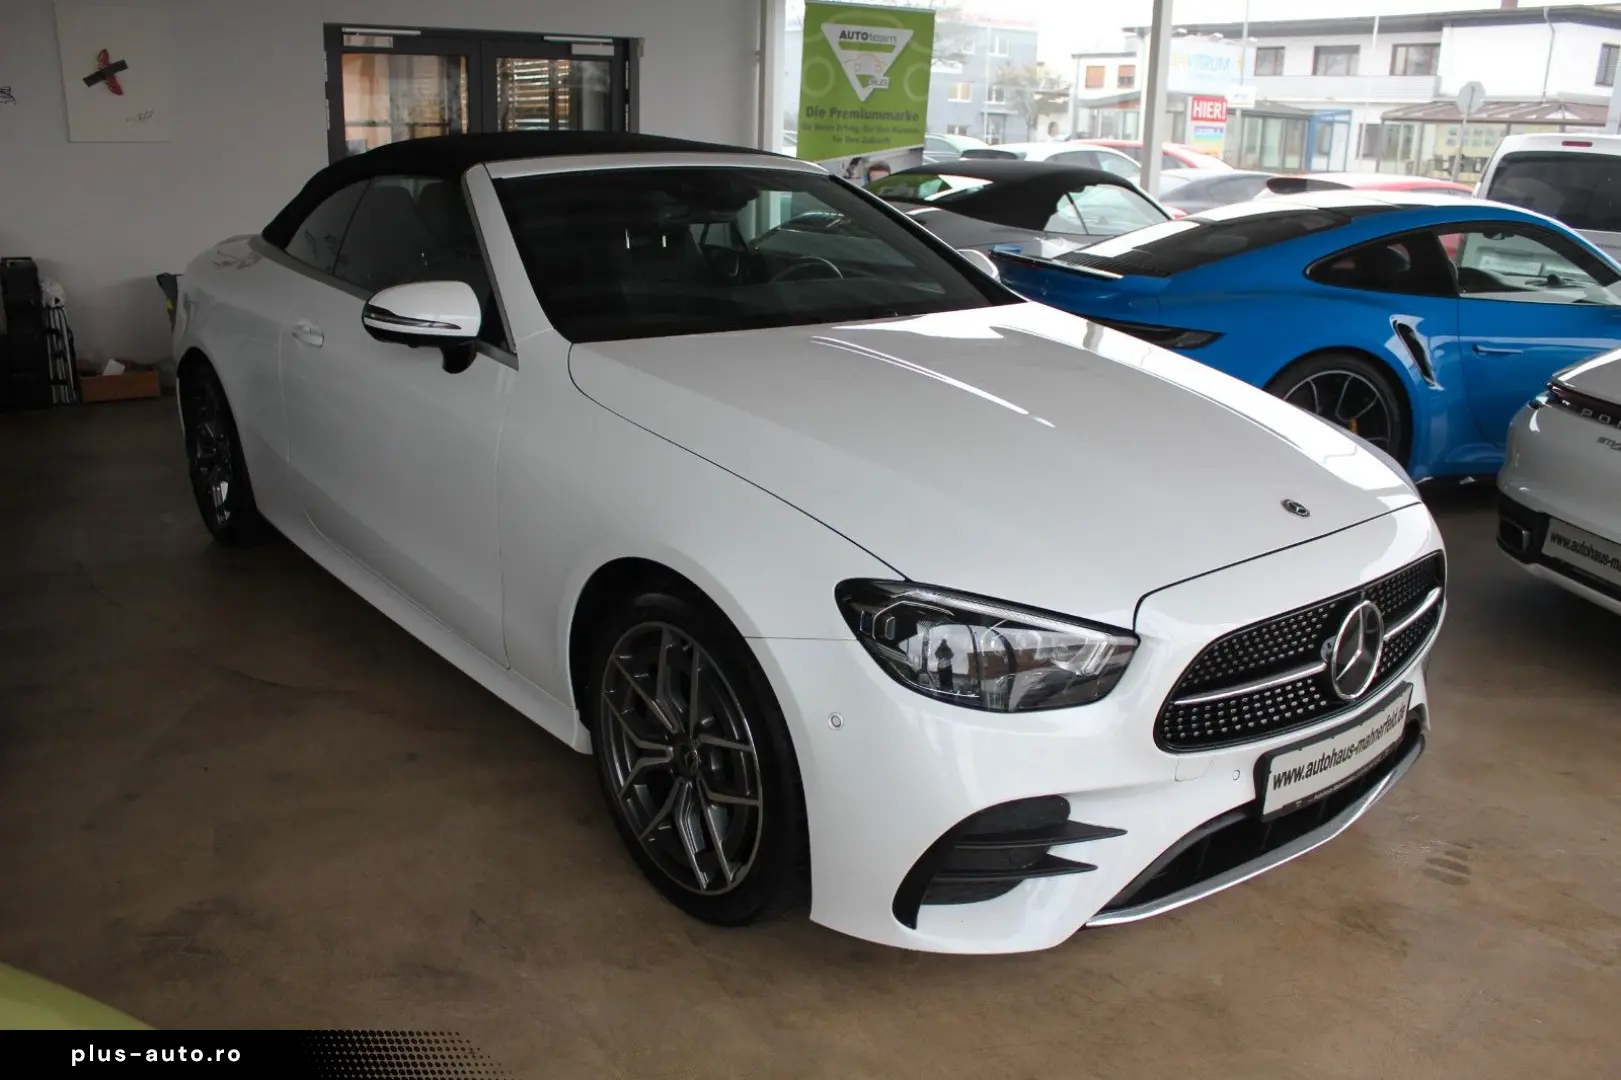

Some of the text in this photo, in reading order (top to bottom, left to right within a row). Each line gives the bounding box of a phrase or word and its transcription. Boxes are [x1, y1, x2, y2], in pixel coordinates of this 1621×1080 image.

[839, 30, 897, 42] AUTOteam
[806, 106, 920, 122] Die Premiummarke
[1193, 100, 1227, 120] HIER!
[1581, 407, 1621, 428] PO
[1272, 702, 1406, 791] www.autohaus-mahnerfeld.de
